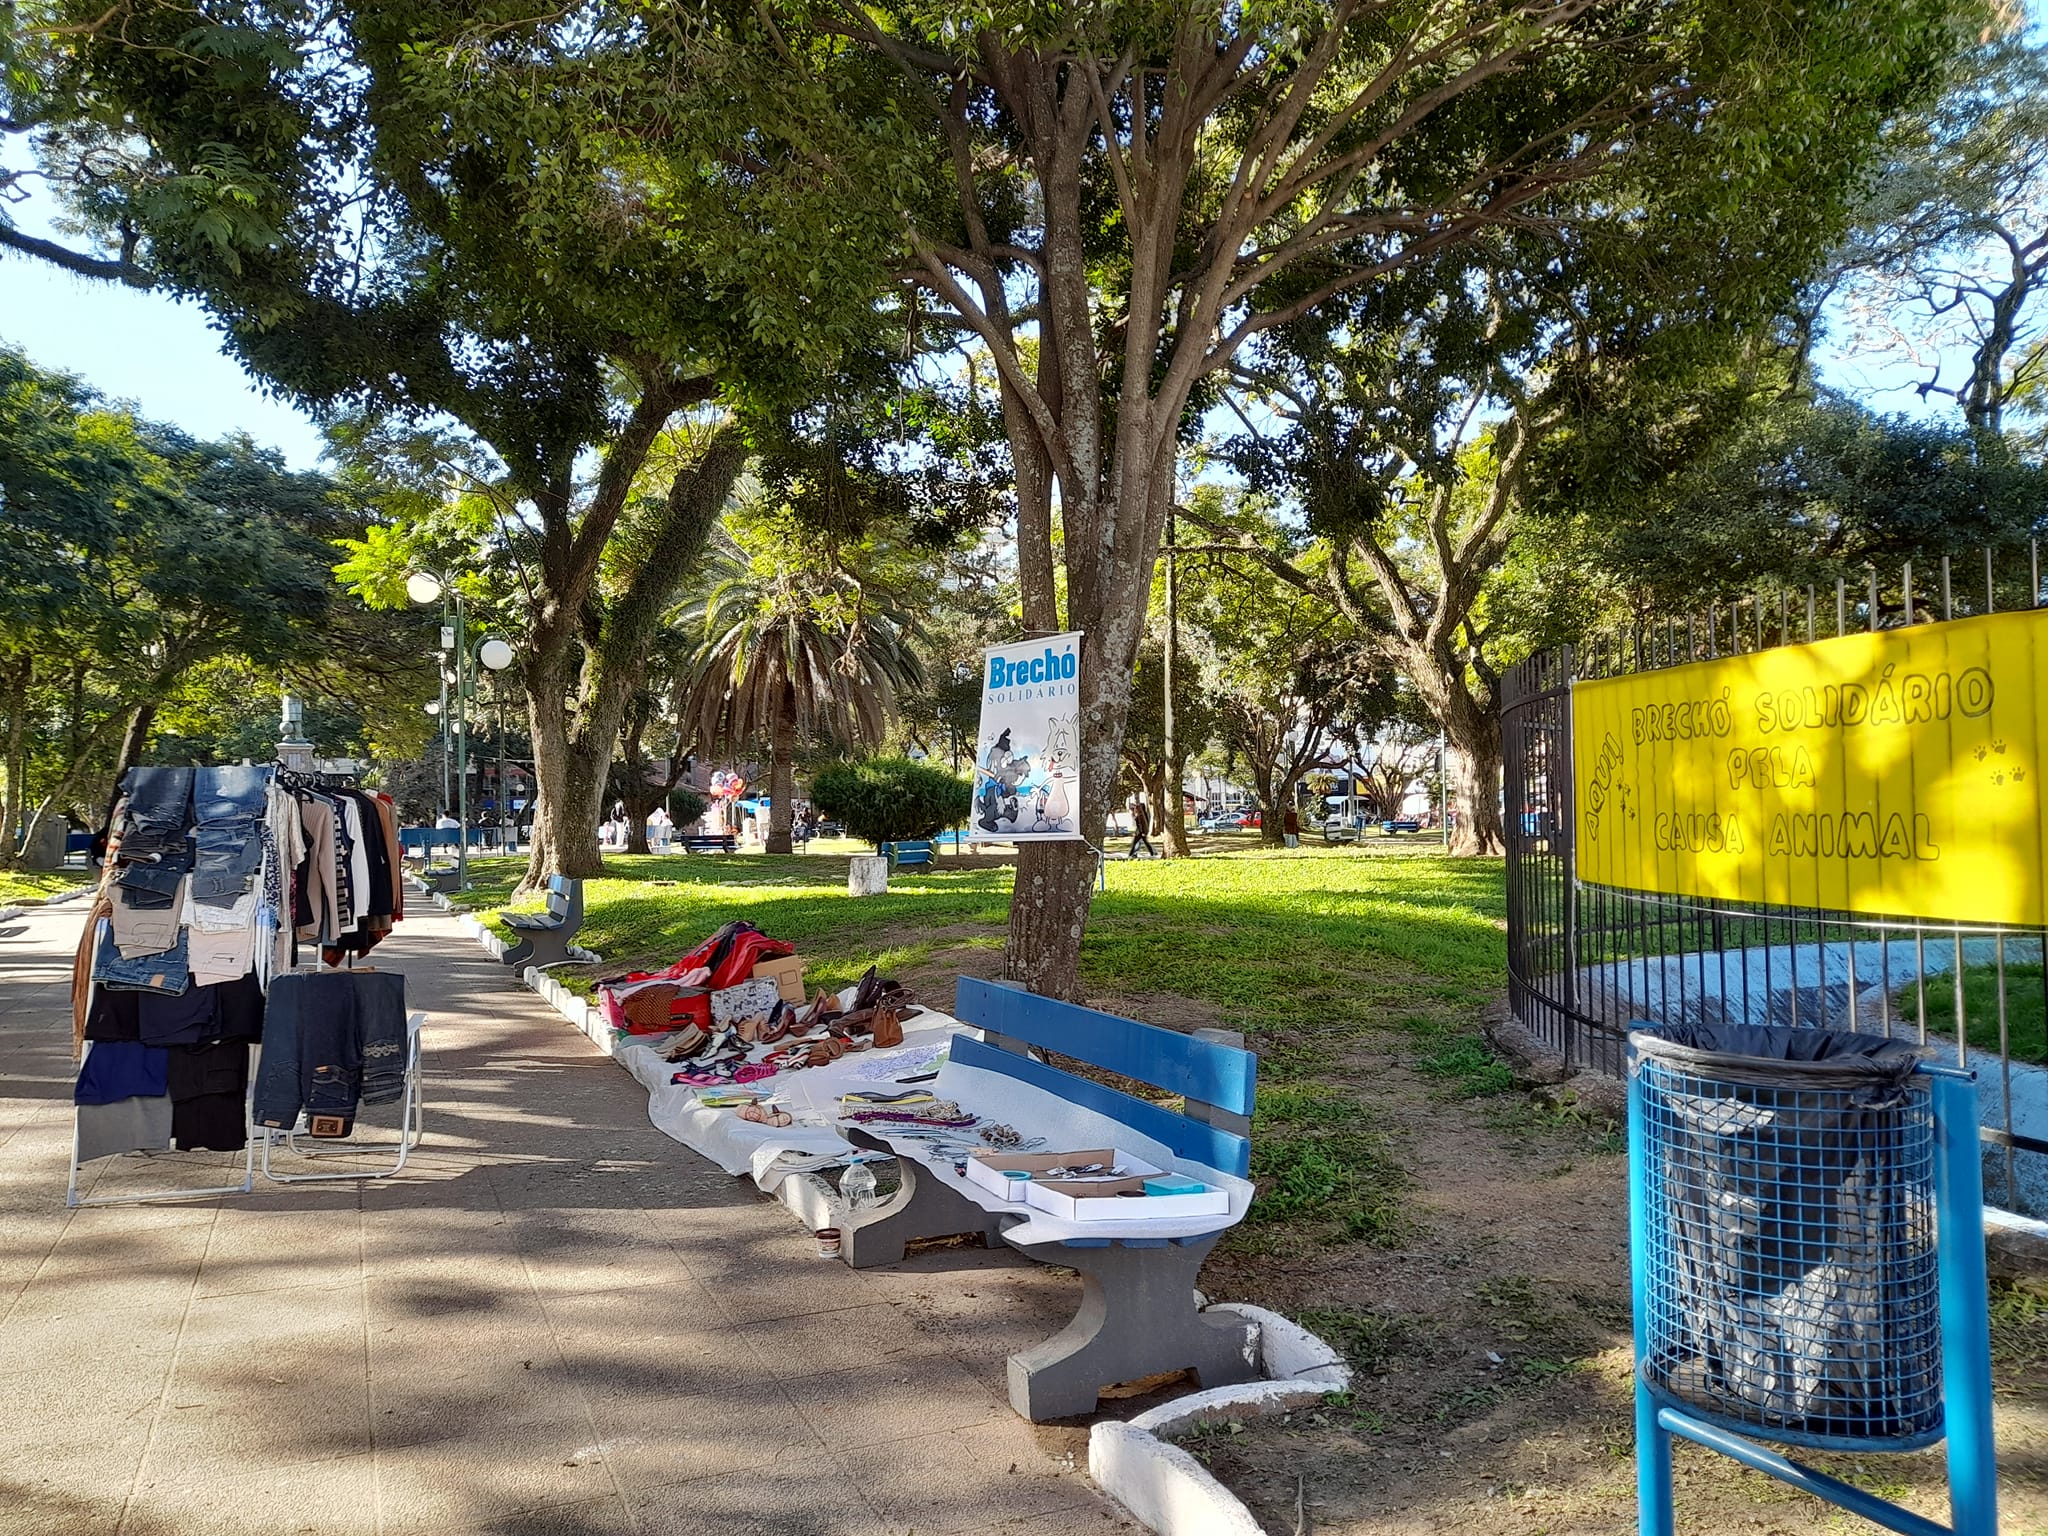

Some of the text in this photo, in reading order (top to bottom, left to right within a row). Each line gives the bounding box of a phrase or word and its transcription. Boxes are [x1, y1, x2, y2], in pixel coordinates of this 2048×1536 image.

[989, 645, 1075, 689] Brechó
[988, 683, 1075, 704] SOLIDÁRIO
[1632, 663, 1994, 745] BRECHÓ SOLIDÁRIO
[1586, 732, 1624, 841] AQUI!
[1728, 746, 1816, 790] PELA
[1654, 811, 1940, 861] CAUSA ANIMAL
